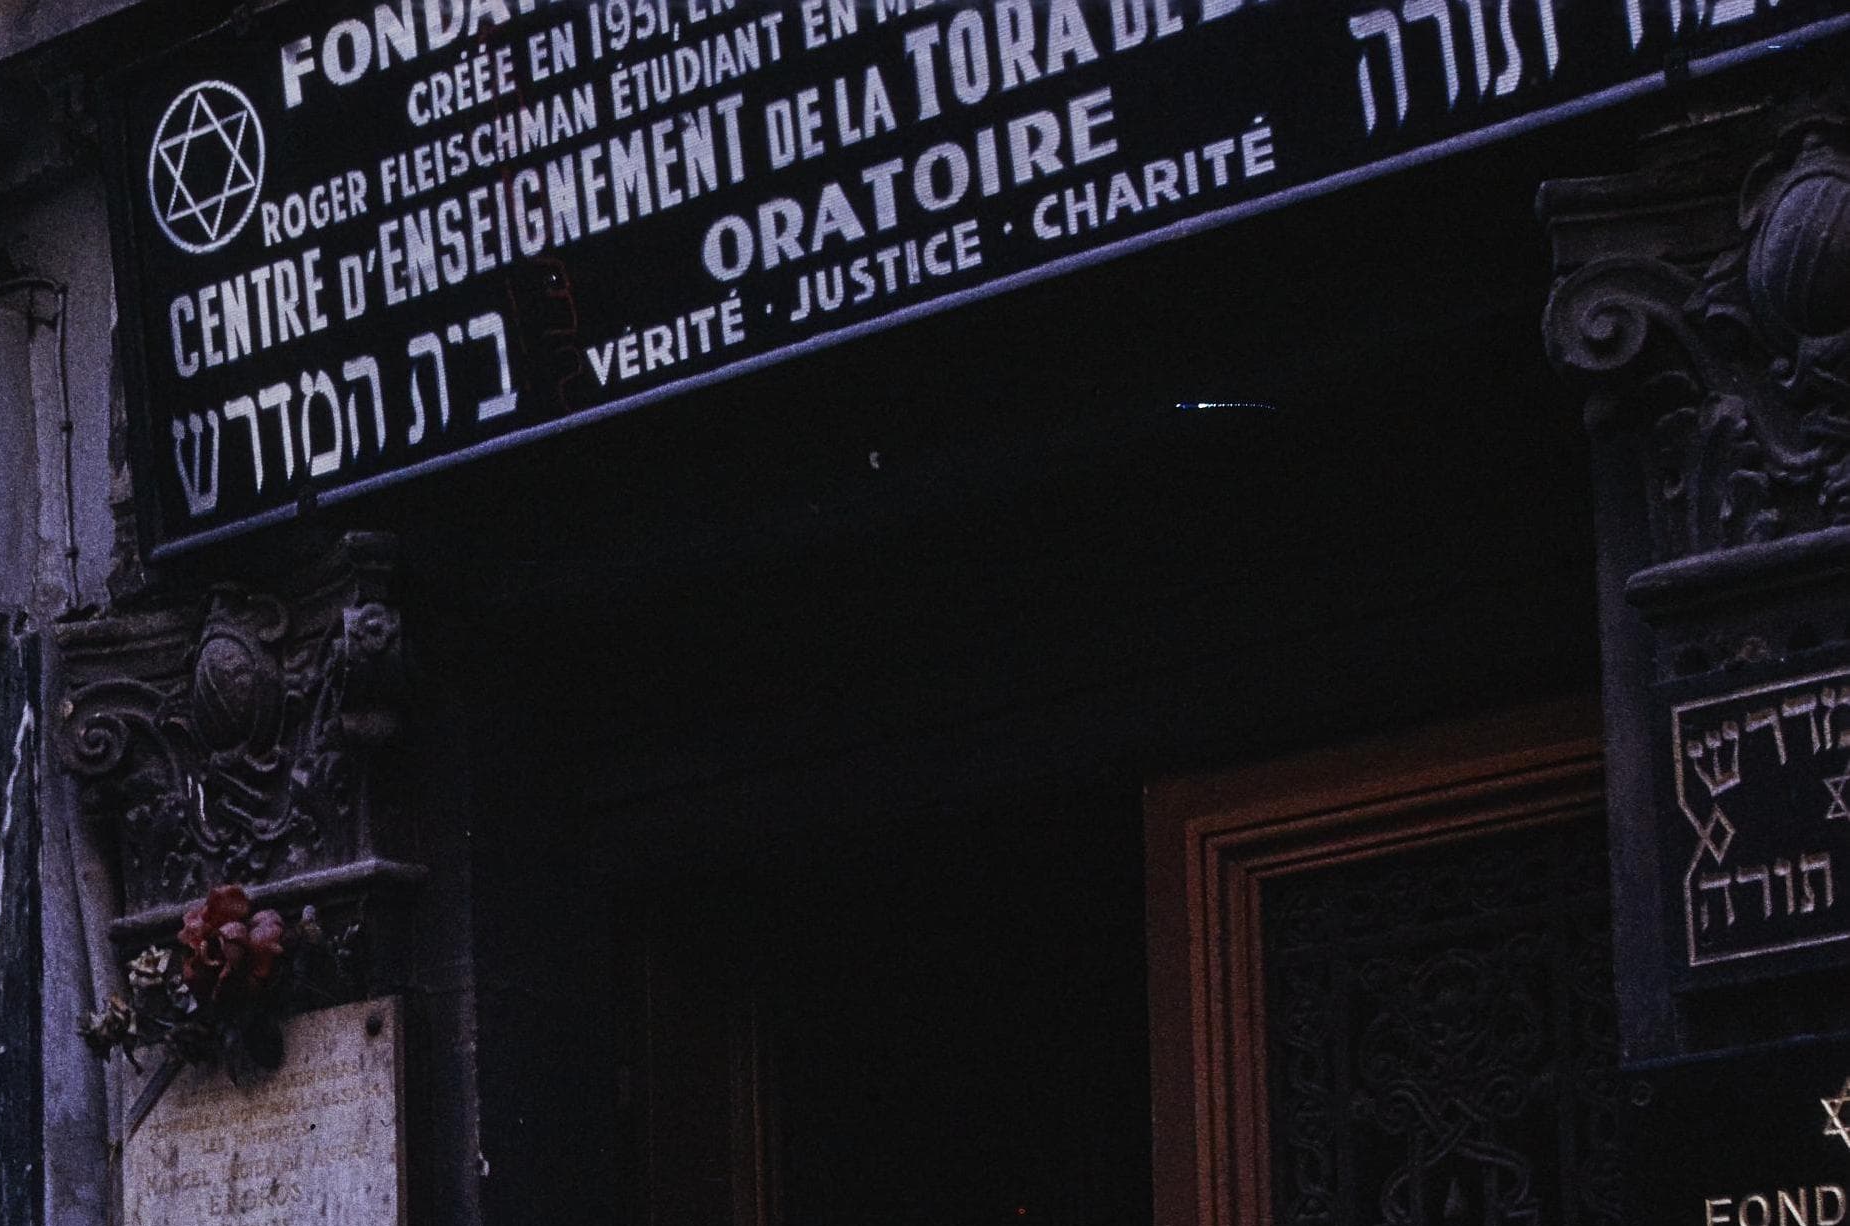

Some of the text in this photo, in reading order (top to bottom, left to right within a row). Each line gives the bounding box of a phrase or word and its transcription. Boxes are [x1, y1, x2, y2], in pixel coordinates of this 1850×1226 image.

[261, 0, 858, 247] ROGER FLEISCHMAN ÉTUDIANT EN
[407, 43, 517, 127] CRÉÉE
[528, 20, 577, 82] EN
[169, 247, 329, 379] CENTRE
[339, 92, 745, 321] D'ENSEIGNEMENT
[765, 87, 826, 171] DE
[834, 65, 897, 147] LA
[905, 0, 1100, 121] TORA
[586, 115, 1277, 387] VÉRITÉ JUSTICE CHARITÉ
[701, 86, 1119, 282] ORATOIRE
[172, 311, 518, 518] בית המדרש
[1699, 852, 1834, 931] תורה
